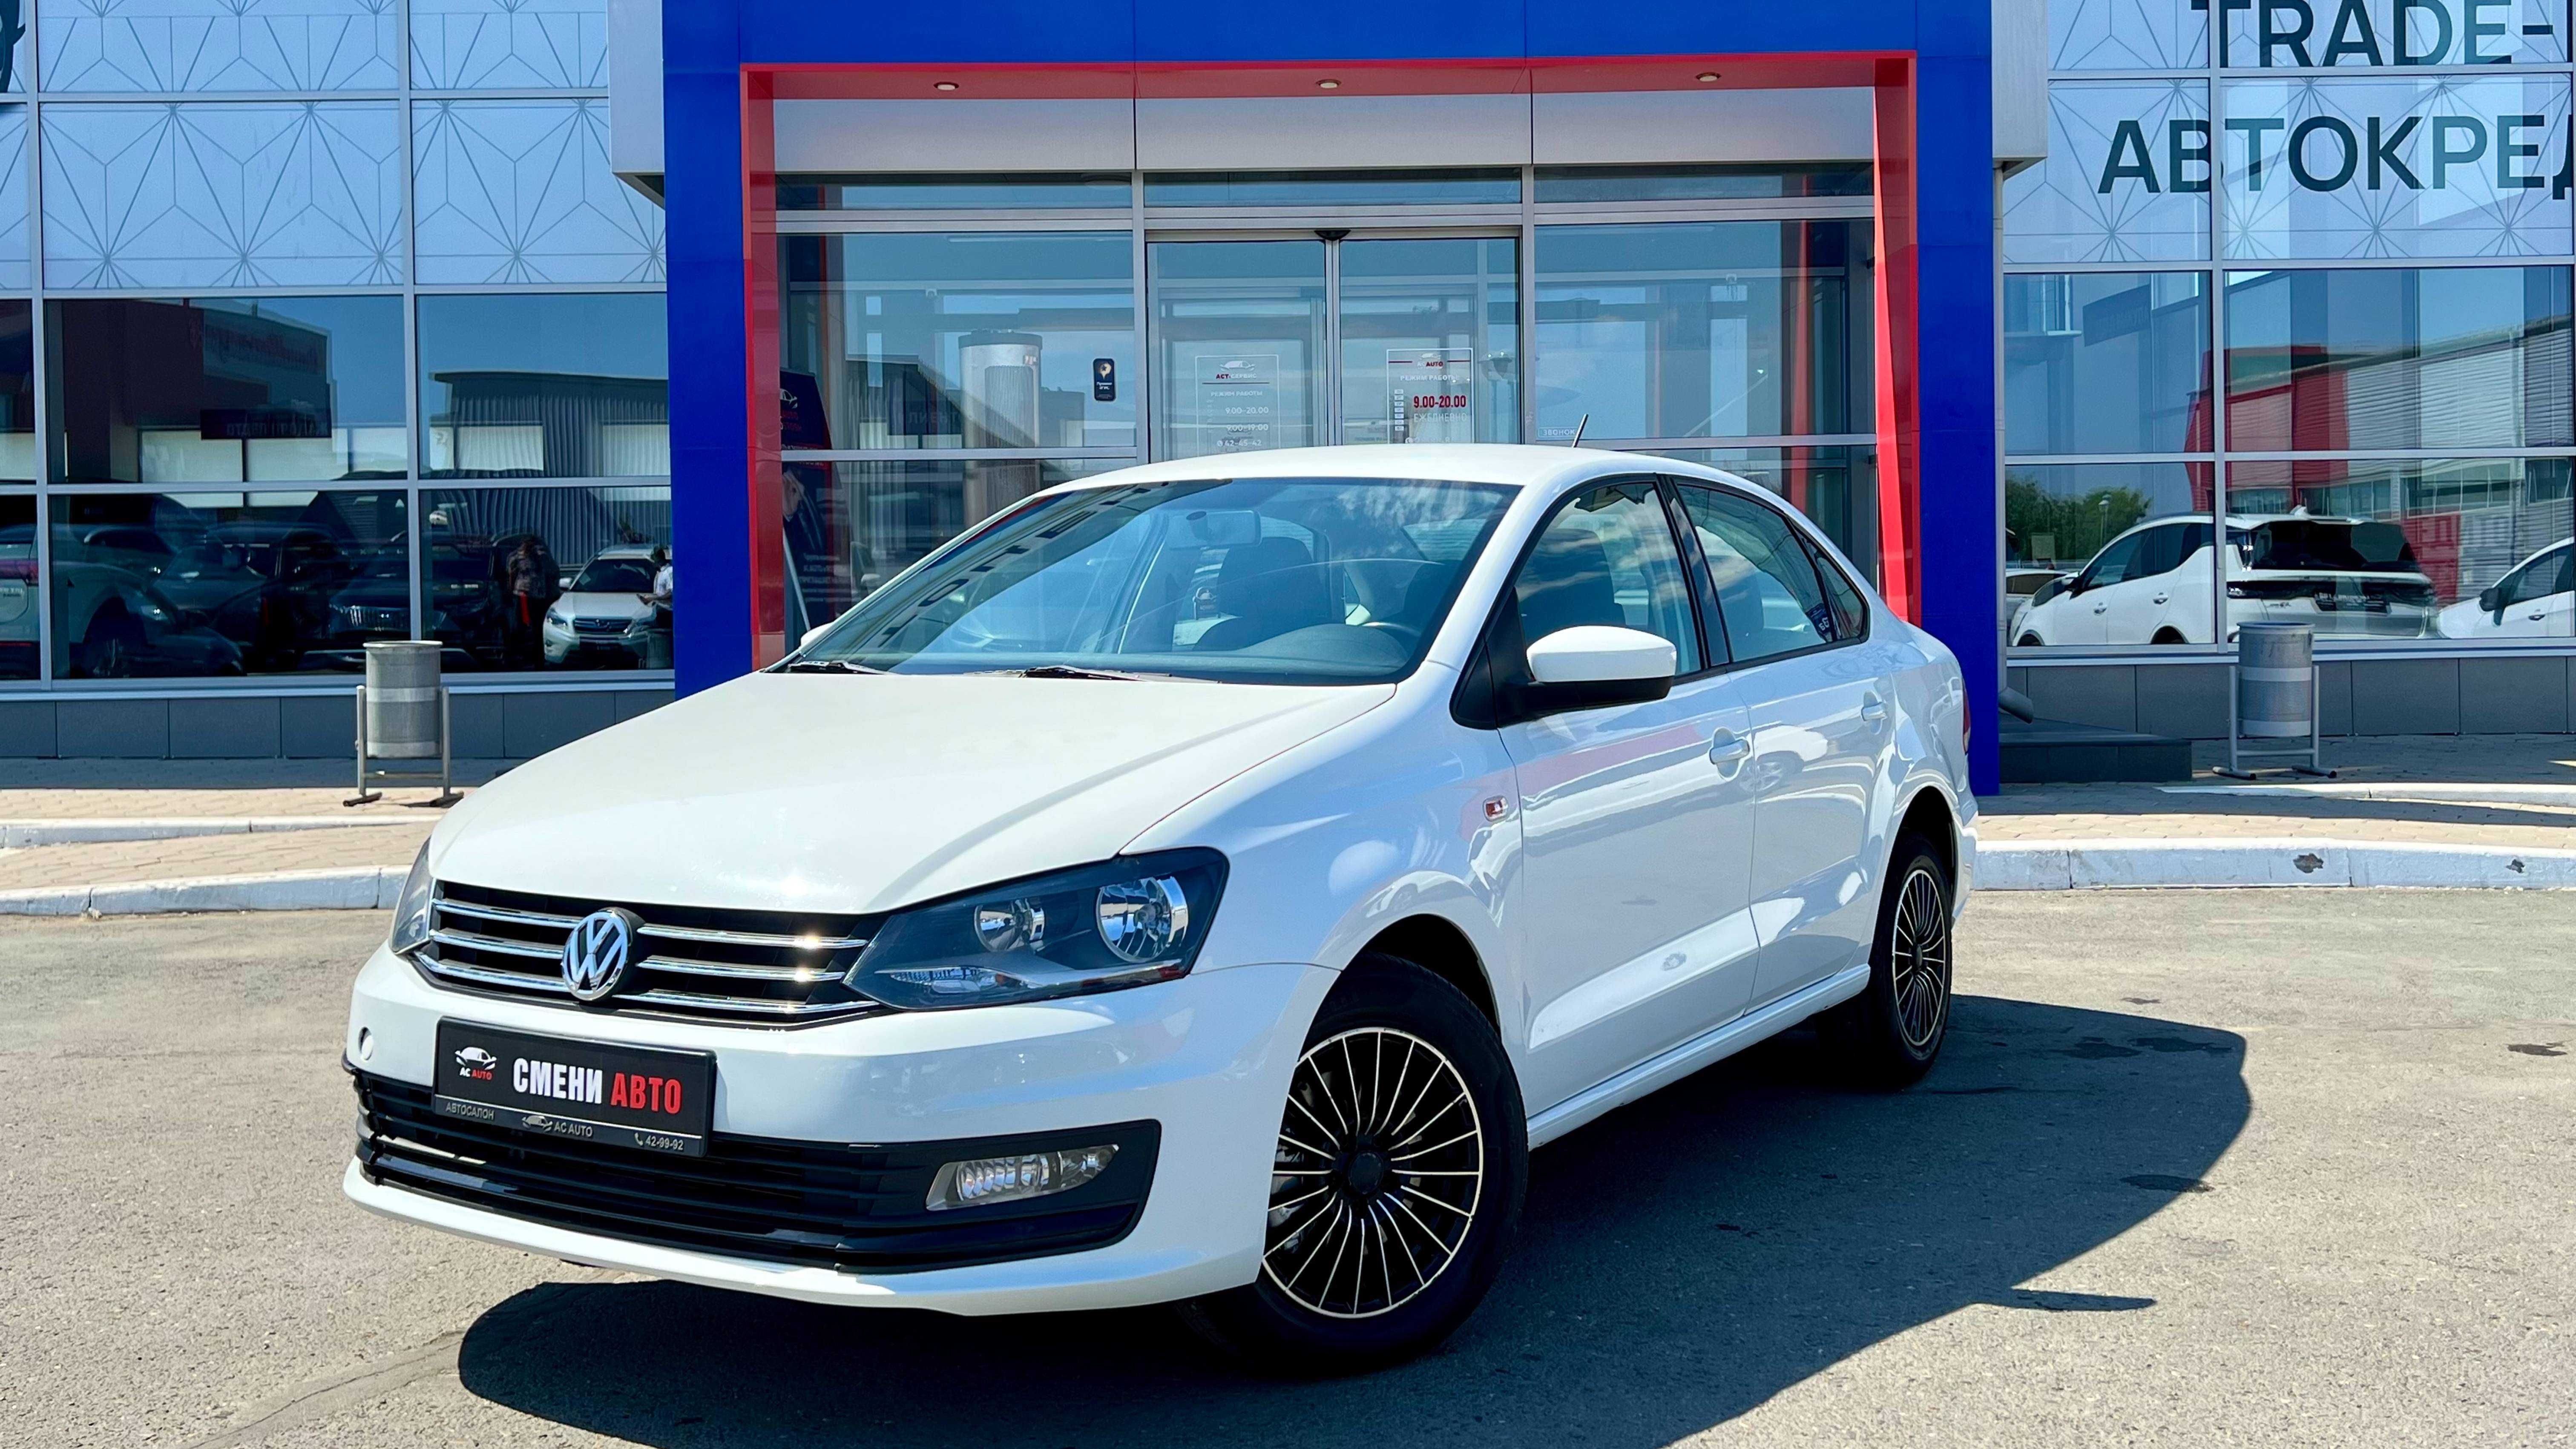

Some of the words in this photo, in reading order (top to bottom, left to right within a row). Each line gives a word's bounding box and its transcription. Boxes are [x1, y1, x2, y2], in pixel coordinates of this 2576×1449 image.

[2098, 114, 2573, 200] АВТОКРЕ
[1414, 395, 1466, 408] 9.00-20.00
[1414, 412, 1467, 423] ЕЖЕДНЕВНО
[460, 1067, 471, 1077] AC
[472, 1070, 492, 1080] AUTO
[512, 1058, 602, 1104] СМЕНИ
[610, 1072, 682, 1116] АВТО
[446, 1101, 494, 1120] АВТОСАЛОН
[554, 1123, 566, 1133] AC
[568, 1124, 593, 1137] AUTO
[645, 1135, 684, 1150] 42-99-92
